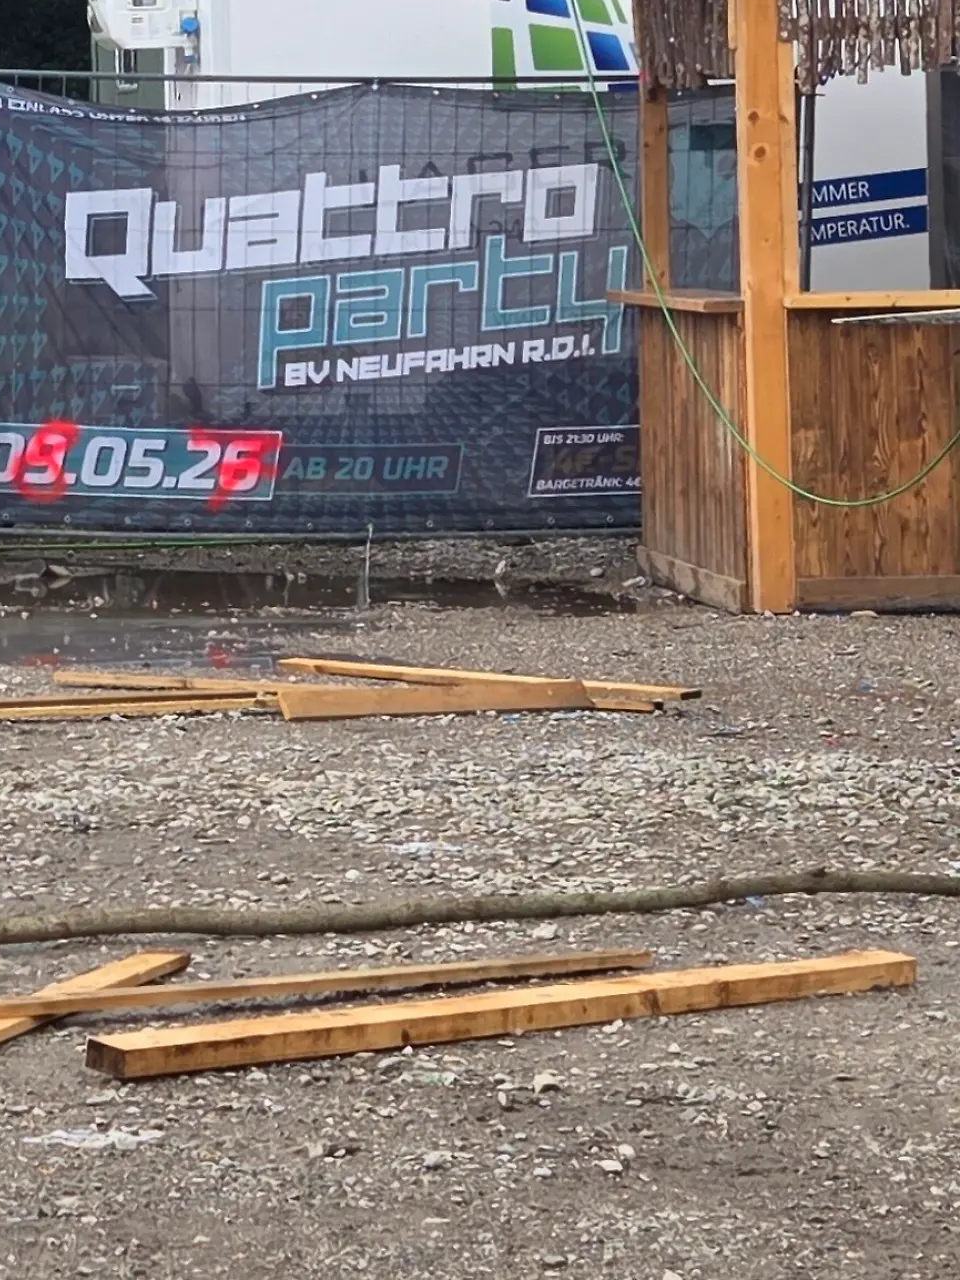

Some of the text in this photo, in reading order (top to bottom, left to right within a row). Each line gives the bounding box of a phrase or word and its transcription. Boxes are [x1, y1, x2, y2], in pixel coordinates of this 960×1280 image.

[812, 180, 870, 204] MMER
[811, 212, 911, 242] MPERATUR.
[257, 235, 628, 391] party
[337, 341, 515, 383] NEUFAHRN
[543, 434, 564, 445] BIS
[282, 455, 449, 480] AB 20 UHR
